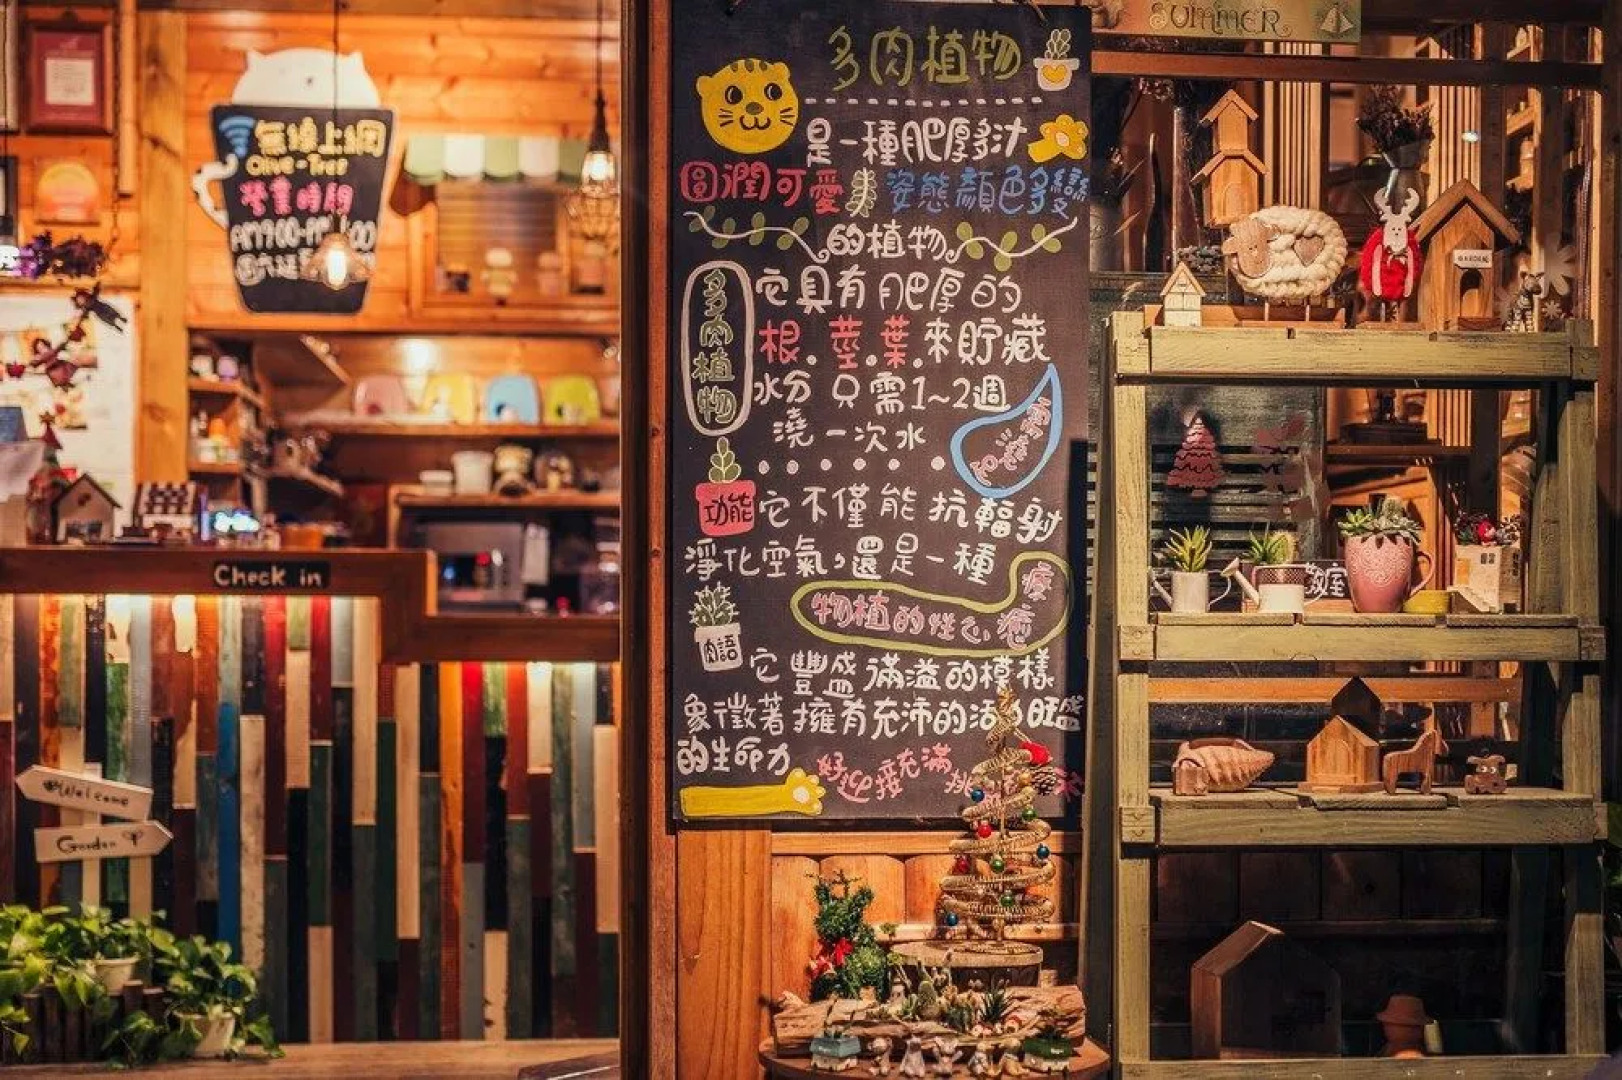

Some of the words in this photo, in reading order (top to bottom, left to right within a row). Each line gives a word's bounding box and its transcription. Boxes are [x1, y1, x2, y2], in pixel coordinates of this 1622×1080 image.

[827, 25, 1022, 92] 多肉植物
[254, 116, 387, 157] 無線上網
[805, 116, 1028, 167] 是一種肥厚多汁
[827, 219, 948, 260] 的植物
[755, 264, 1023, 314] 它具有肥厚的
[691, 268, 738, 424] 多肉植物
[772, 406, 927, 454] 澆一次水
[704, 492, 754, 527] 功能
[757, 482, 1063, 543] 它不僅能抗輻射
[213, 563, 287, 587] Check
[300, 567, 323, 587] in
[676, 735, 793, 777] 的生命力
